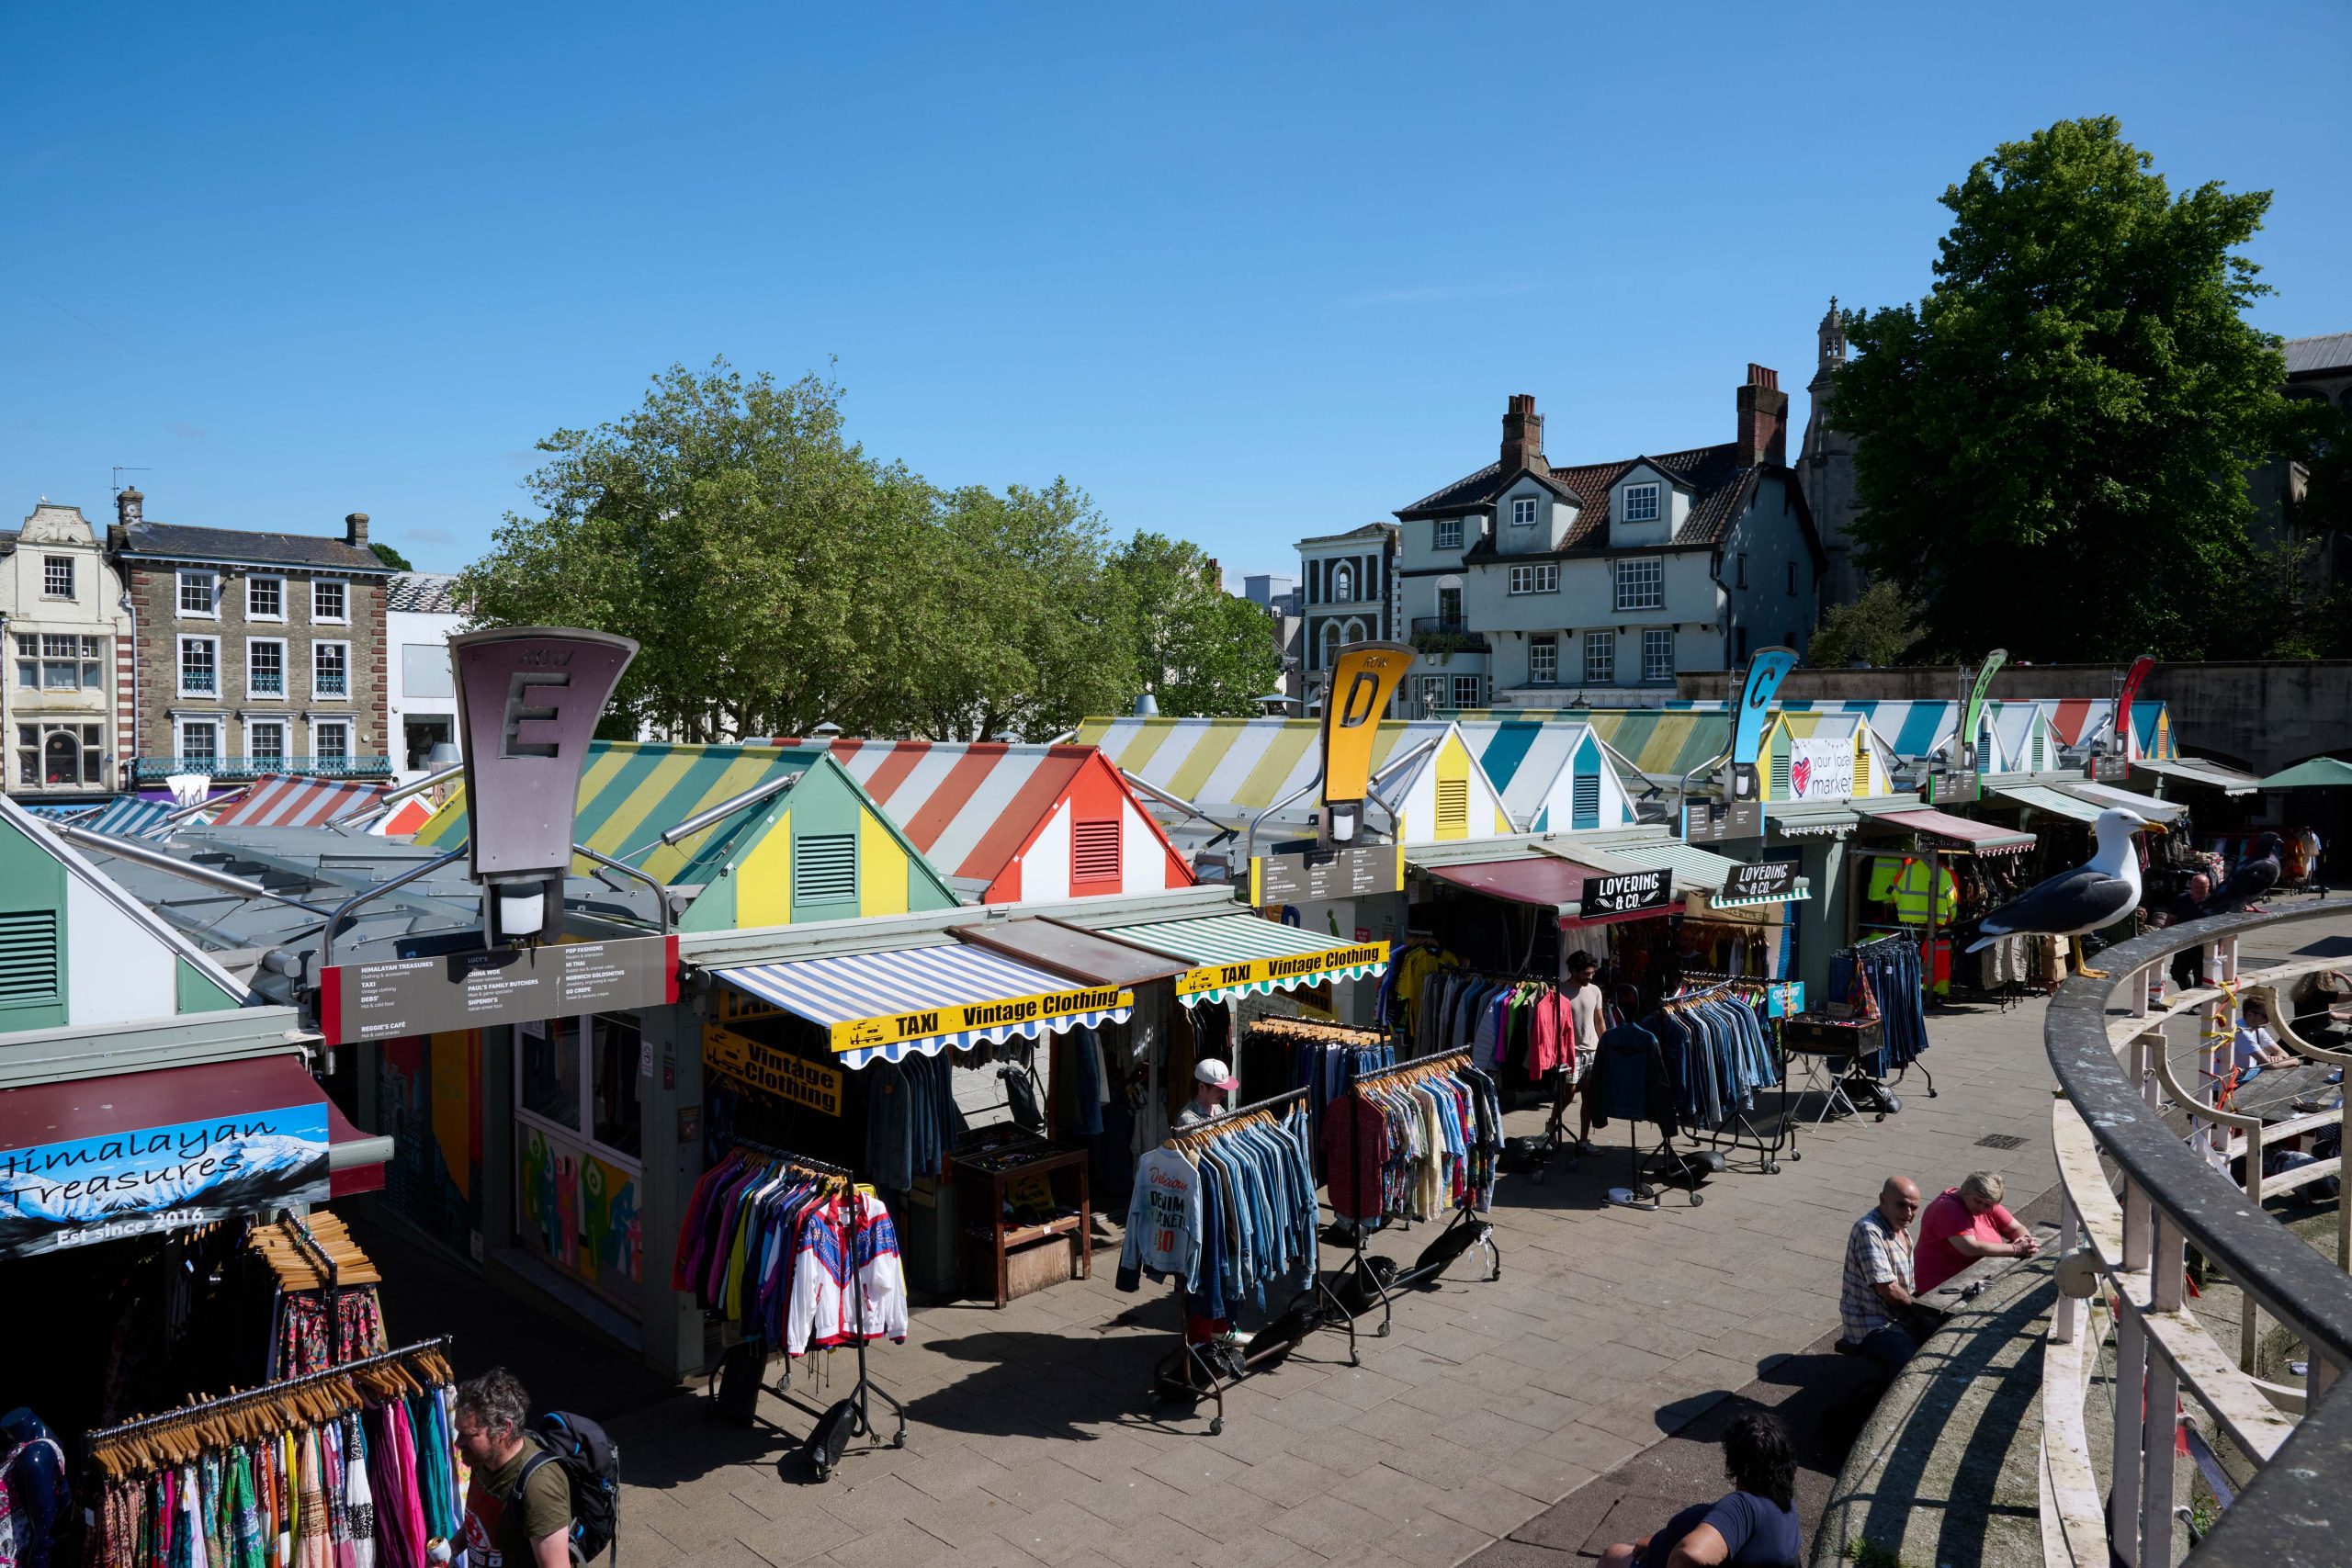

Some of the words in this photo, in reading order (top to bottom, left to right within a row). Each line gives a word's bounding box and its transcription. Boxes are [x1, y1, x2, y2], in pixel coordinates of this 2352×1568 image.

[518, 649, 575, 668] ROW
[1363, 656, 1390, 668] ROW
[1340, 671, 1379, 728] D
[1750, 667, 1776, 709] C
[498, 671, 571, 759] E
[1812, 756, 1831, 771] your
[1812, 773, 1851, 795] market
[1739, 863, 1788, 882] LOVERING
[1600, 873, 1659, 897] LOVERING
[1749, 883, 1757, 895] &
[1757, 881, 1770, 894] CO.
[1615, 896, 1624, 910] &
[1625, 894, 1641, 909] CO.
[361, 964, 397, 974] HIMALAYAN
[399, 961, 434, 970] TREASURES
[592, 970, 625, 979] GOLDSMITHS
[1220, 964, 1250, 984] TAXI
[1268, 956, 1322, 976] Vintage
[1325, 947, 1379, 968] Clothing
[489, 981, 509, 989] FAMILY
[509, 978, 539, 987] BUTCHERS
[895, 1012, 938, 1037] TAXI
[963, 1001, 1037, 1027] Vintage
[1042, 989, 1119, 1015] Clothing
[361, 1023, 390, 1032] REGGIE'S
[390, 1021, 406, 1029] CAFÉ
[748, 1043, 834, 1089] Vintage
[744, 1061, 836, 1111] Clothing
[0, 1121, 277, 1179] Himalayan
[0, 1154, 243, 1209] Treasures
[1149, 1167, 1188, 1191] Delicious
[1150, 1190, 1184, 1213] DENIM
[57, 1228, 87, 1247] Est
[95, 1219, 146, 1241] since
[153, 1207, 204, 1231] 2016
